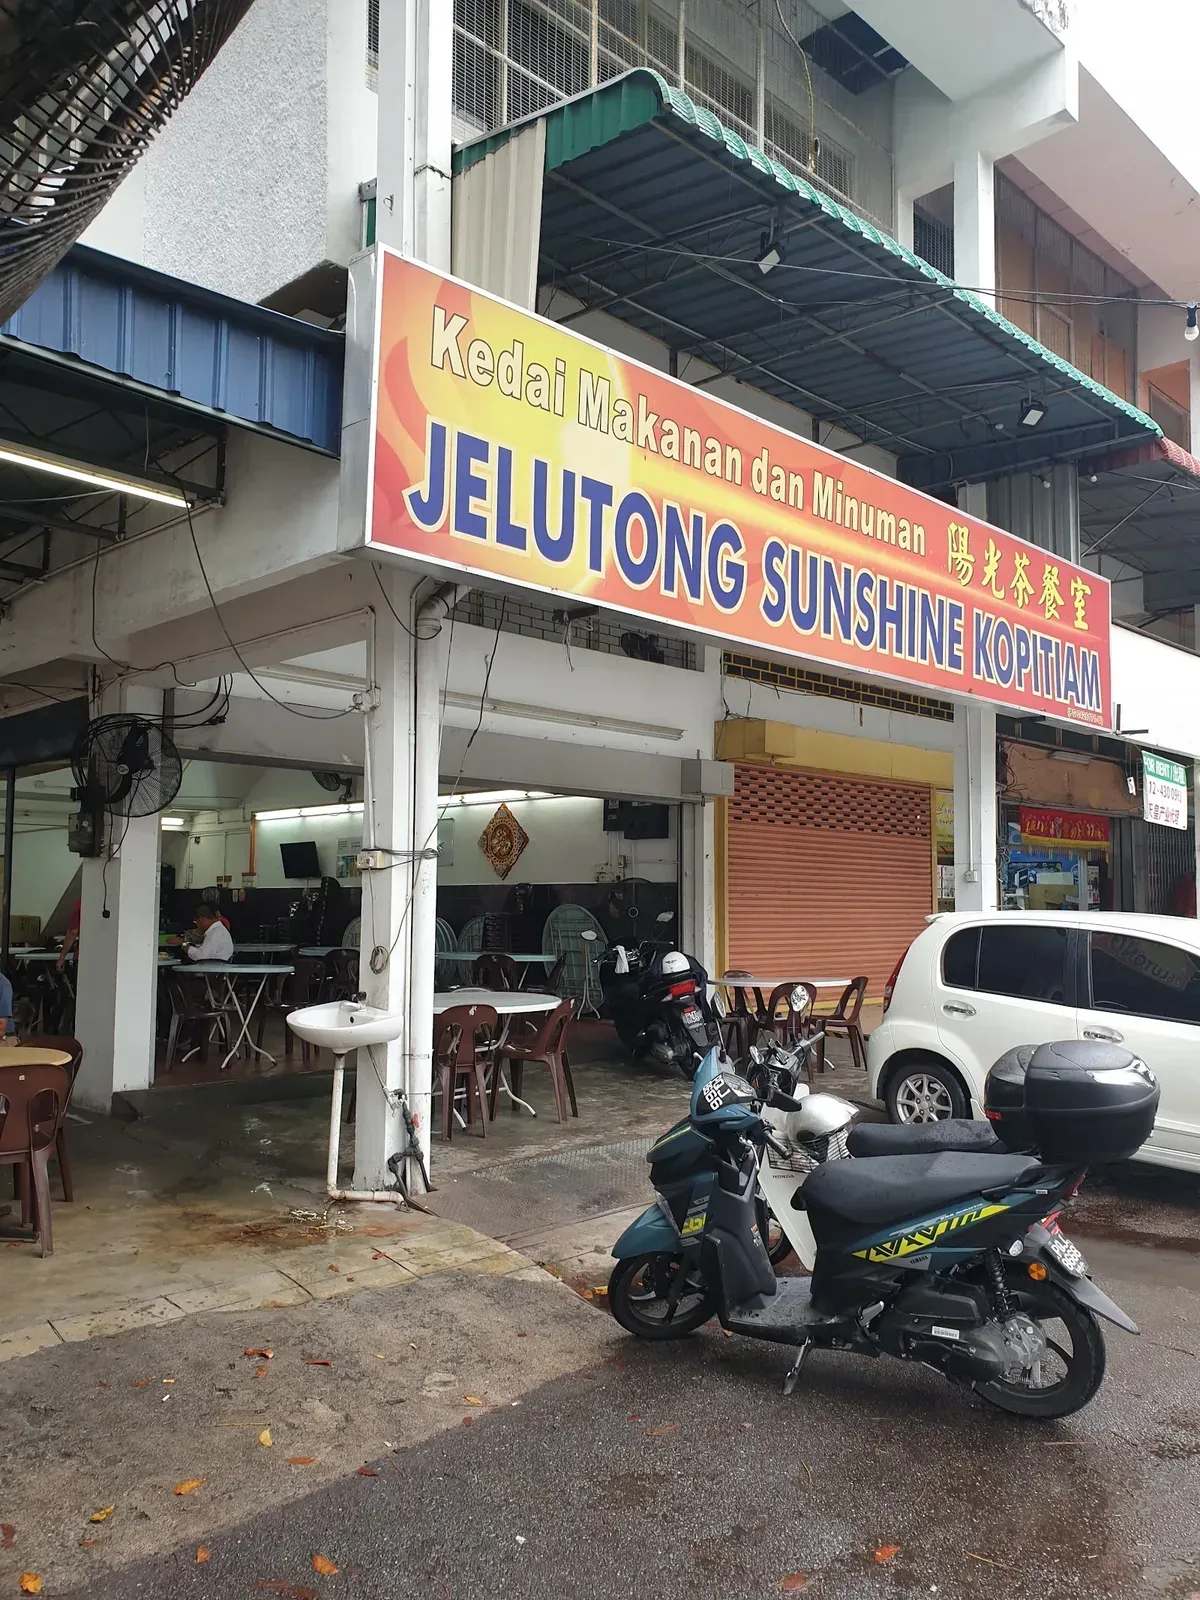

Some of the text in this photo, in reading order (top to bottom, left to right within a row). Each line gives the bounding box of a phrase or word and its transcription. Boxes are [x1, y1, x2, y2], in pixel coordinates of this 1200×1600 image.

[430, 304, 926, 556] Kedai Makanan dan Minuman
[403, 415, 1102, 713] JELUTONG SUNSHINE KOPITIAM
[946, 521, 1092, 631] 陽光茶餐室
[1156, 760, 1170, 779] RENT
[909, 1255, 929, 1265] YAMAHA
